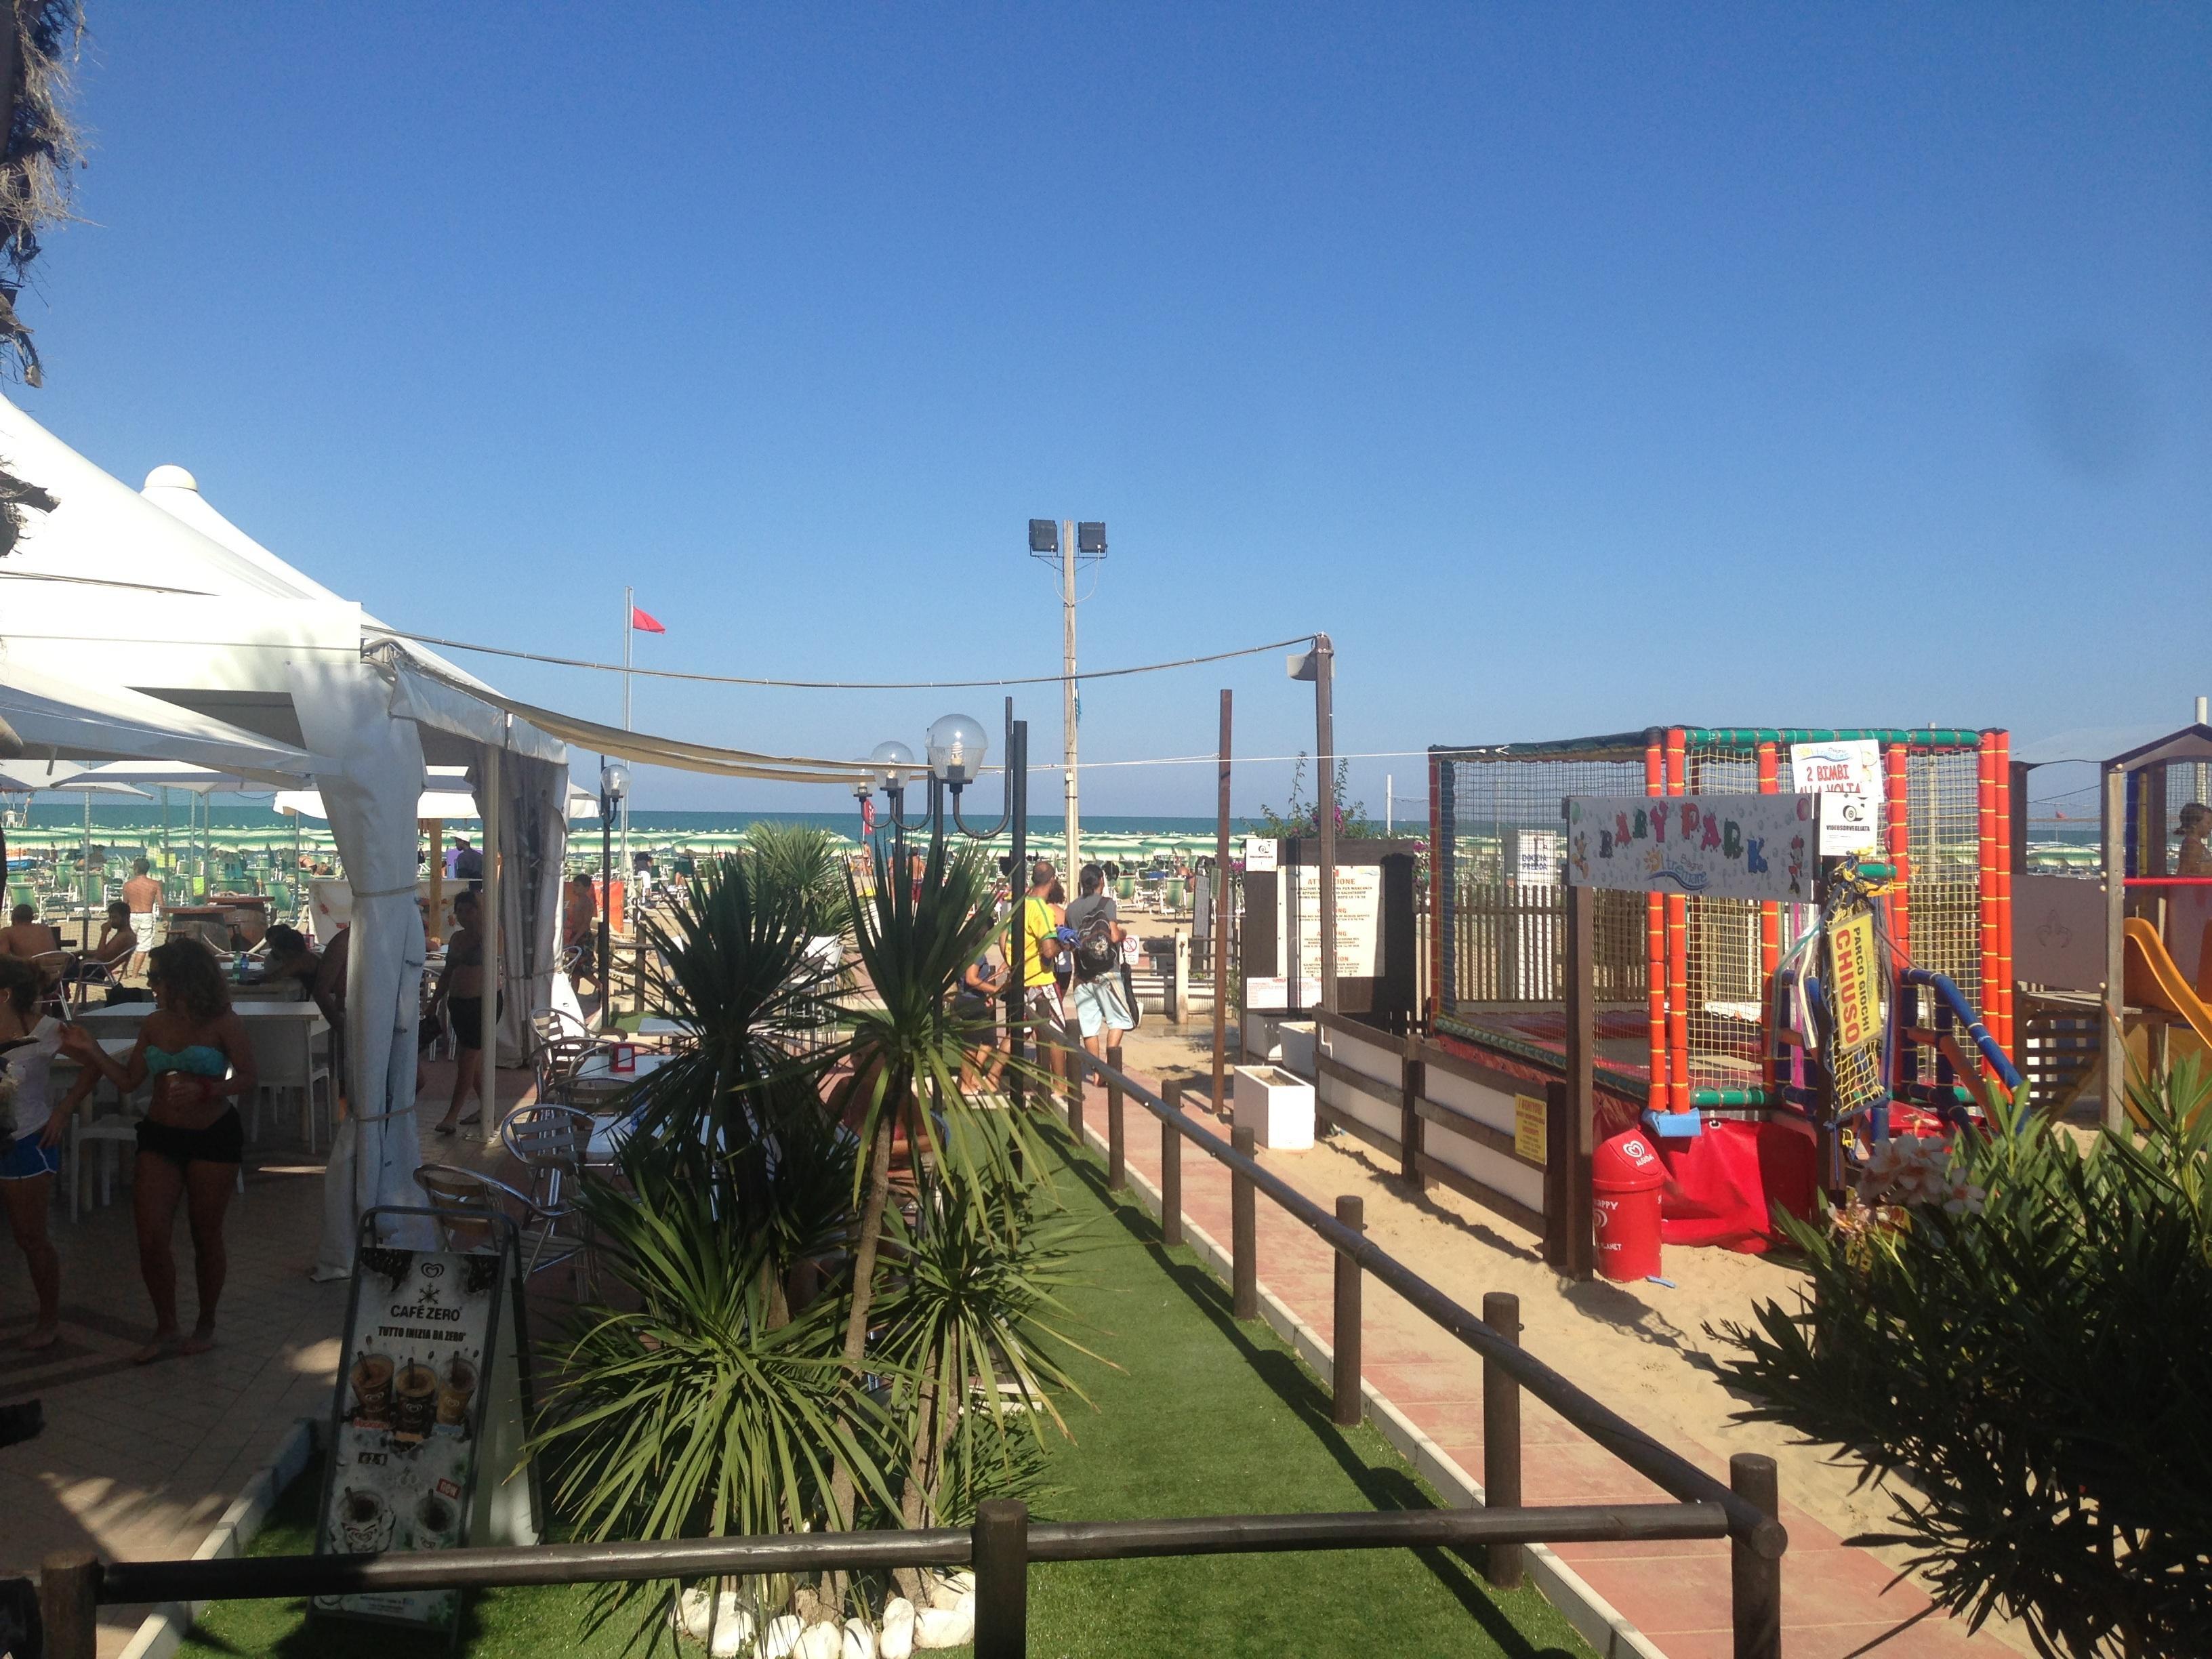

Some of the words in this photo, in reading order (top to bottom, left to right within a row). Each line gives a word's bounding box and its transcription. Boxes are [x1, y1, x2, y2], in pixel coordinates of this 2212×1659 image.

[1806, 766, 1813, 781] 2
[1816, 764, 1849, 781] BIMBI
[1599, 800, 1668, 859] BABY
[1680, 802, 1769, 874] PARK
[1853, 926, 1864, 976] PARCO
[1836, 929, 1860, 1044] CHIUSO
[1858, 981, 1870, 1031] GIOCHI
[1635, 1153, 1655, 1167] ALGIDA
[390, 1304, 424, 1319] CAFÉ
[378, 1326, 404, 1338] TUTTO
[406, 1328, 431, 1339] INIZIA
[432, 1330, 443, 1340] DA
[441, 1481, 458, 1496] new
